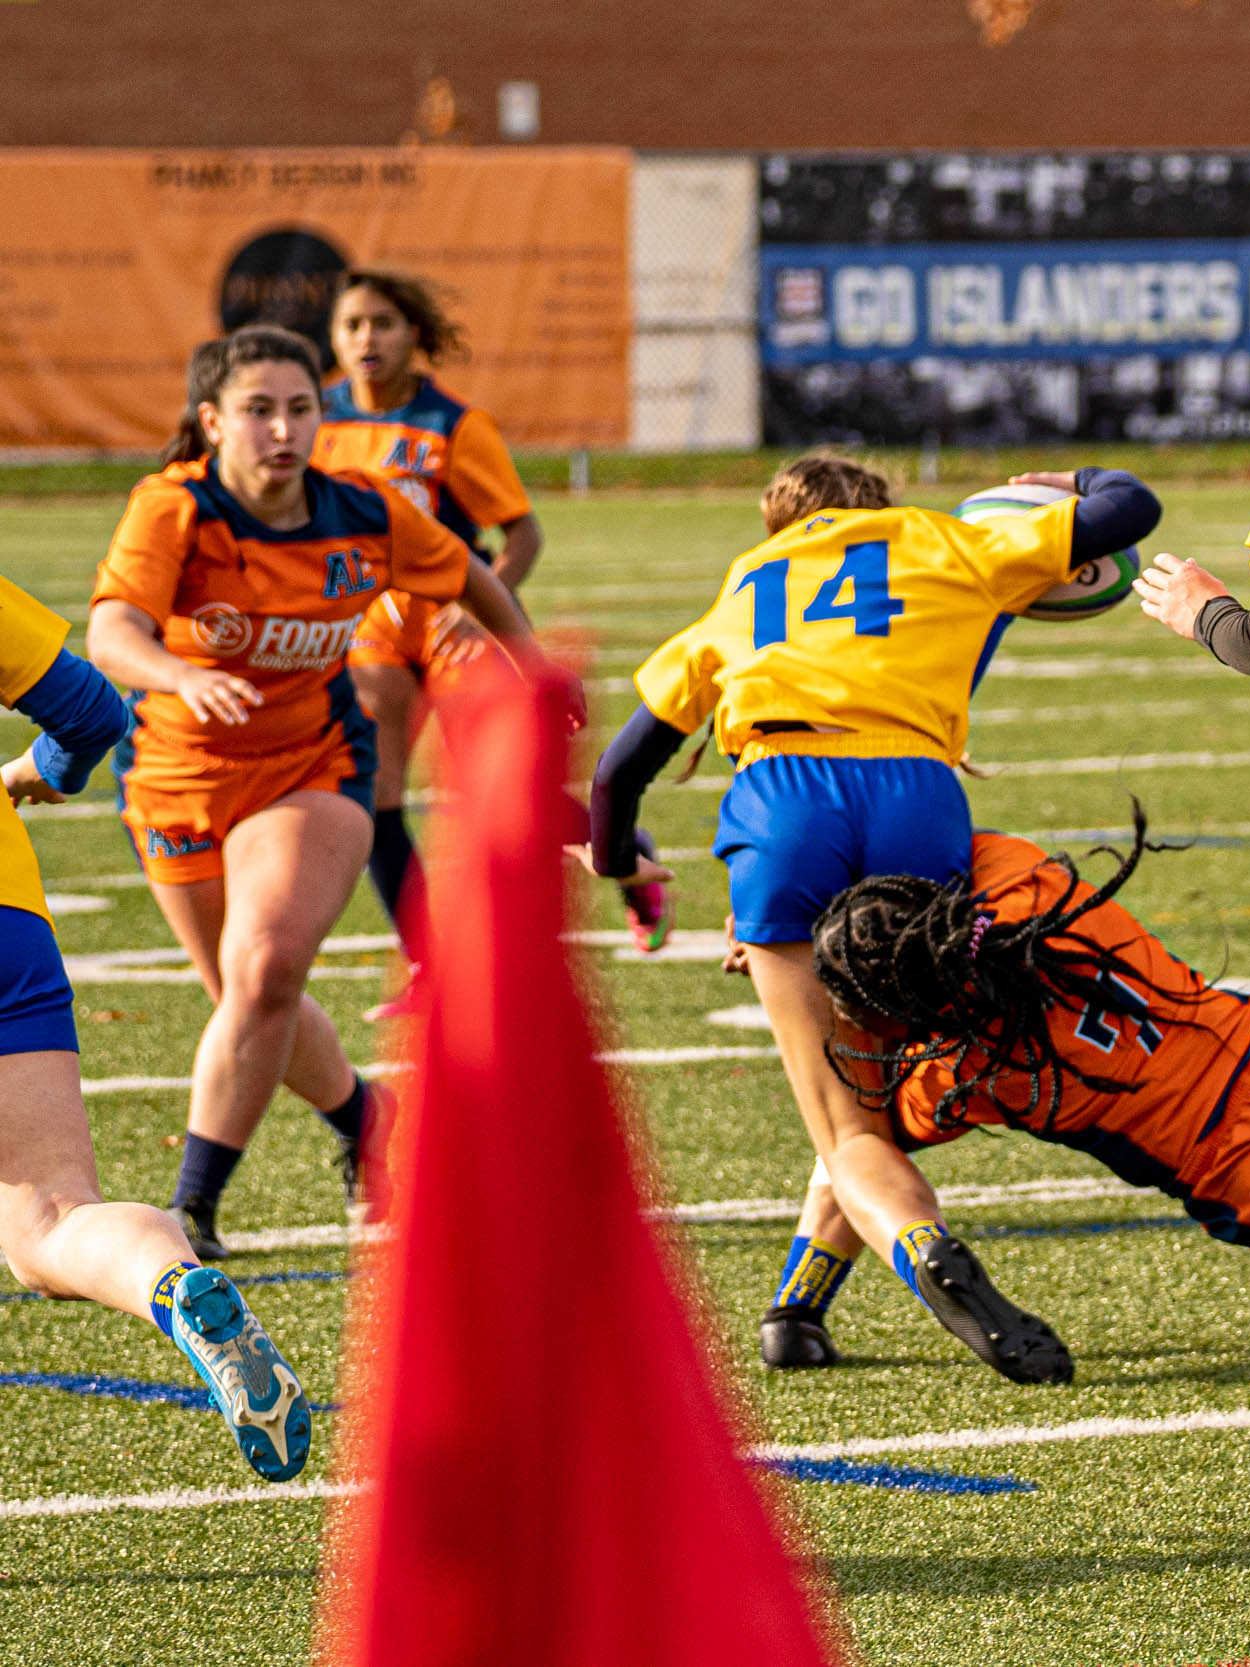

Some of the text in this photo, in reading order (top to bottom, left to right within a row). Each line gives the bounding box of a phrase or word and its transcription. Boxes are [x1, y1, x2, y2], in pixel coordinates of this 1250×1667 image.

[833, 264, 917, 349] GO
[925, 260, 1242, 347] ISLANDERS
[324, 549, 376, 598] AL
[733, 540, 904, 651] 14
